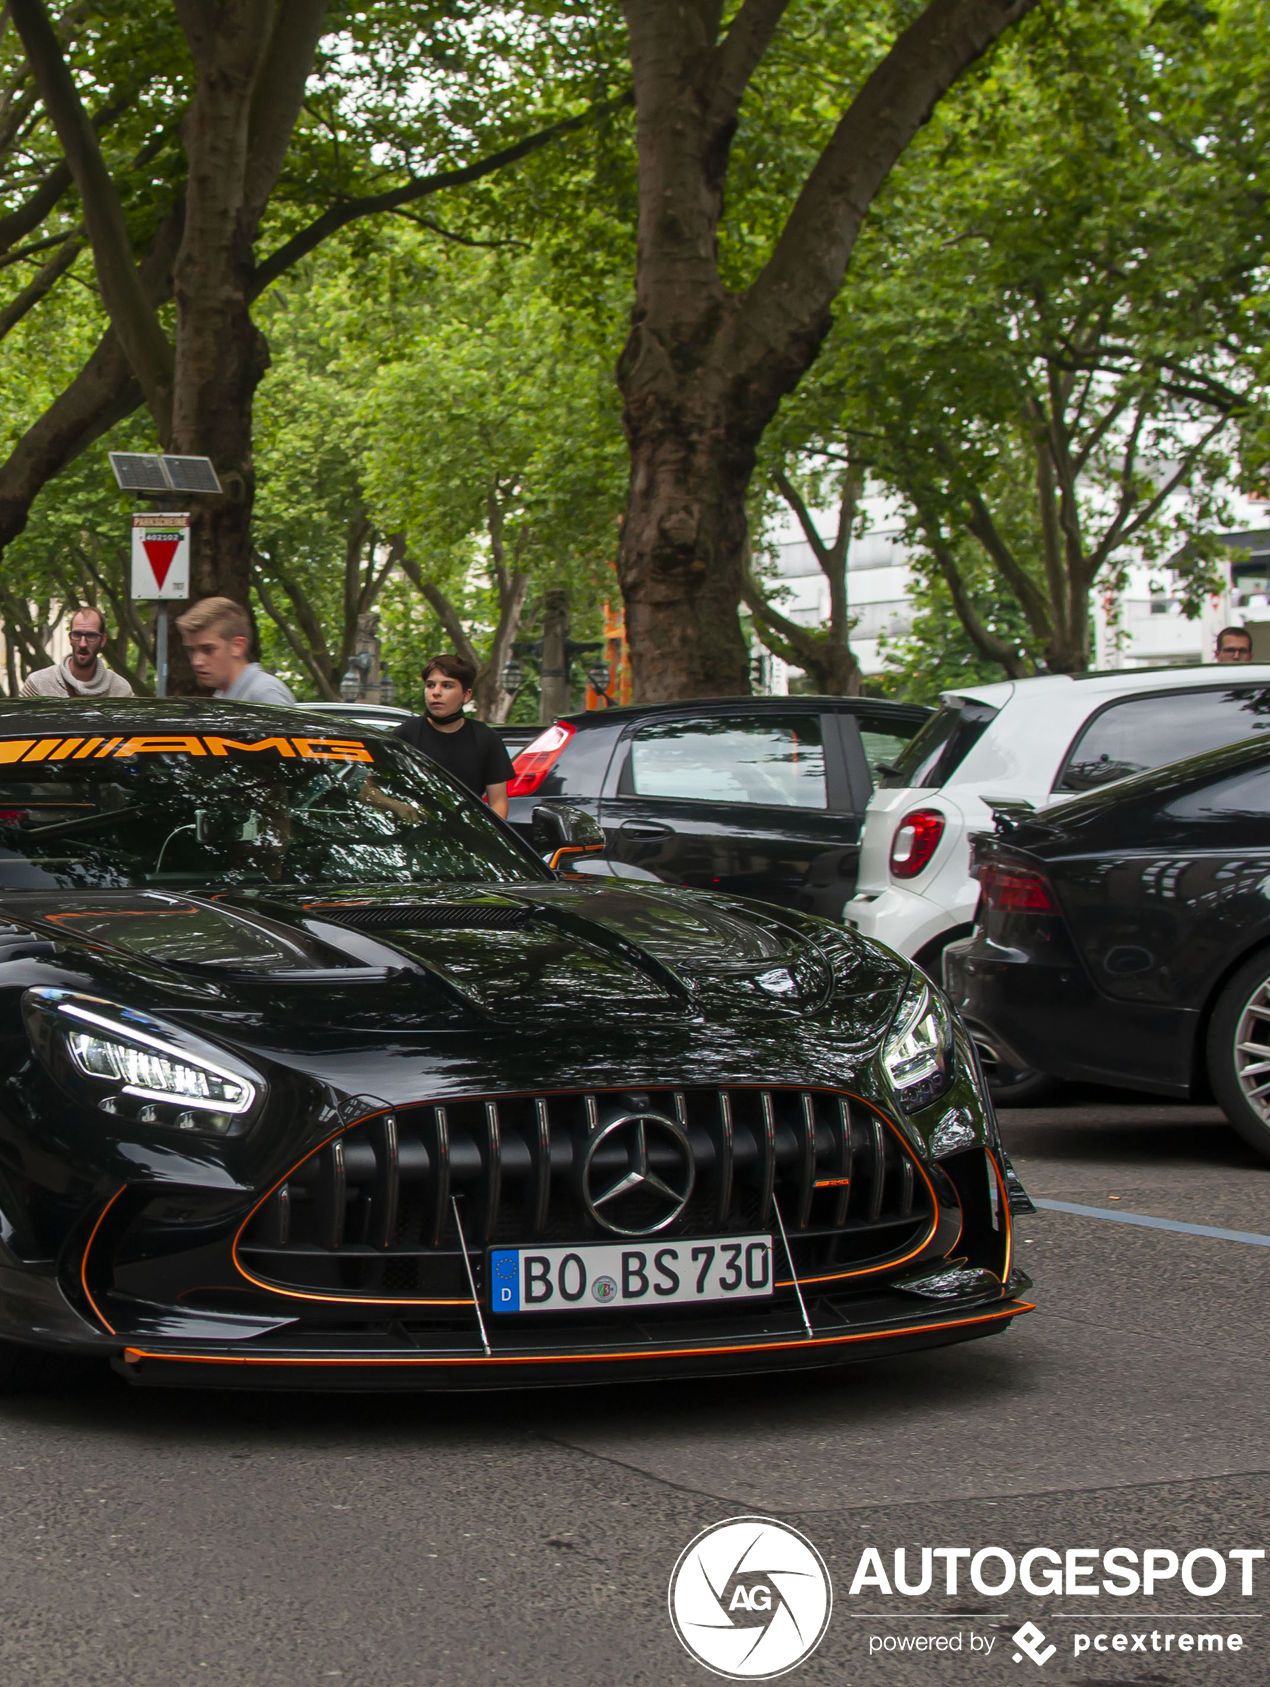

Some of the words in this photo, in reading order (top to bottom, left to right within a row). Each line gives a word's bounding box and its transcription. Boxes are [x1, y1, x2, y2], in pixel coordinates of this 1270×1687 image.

[114, 736, 375, 764] AMG
[501, 1288, 512, 1302] D
[524, 1253, 587, 1304] BO
[622, 1248, 680, 1298] BS
[691, 1242, 770, 1293] 730
